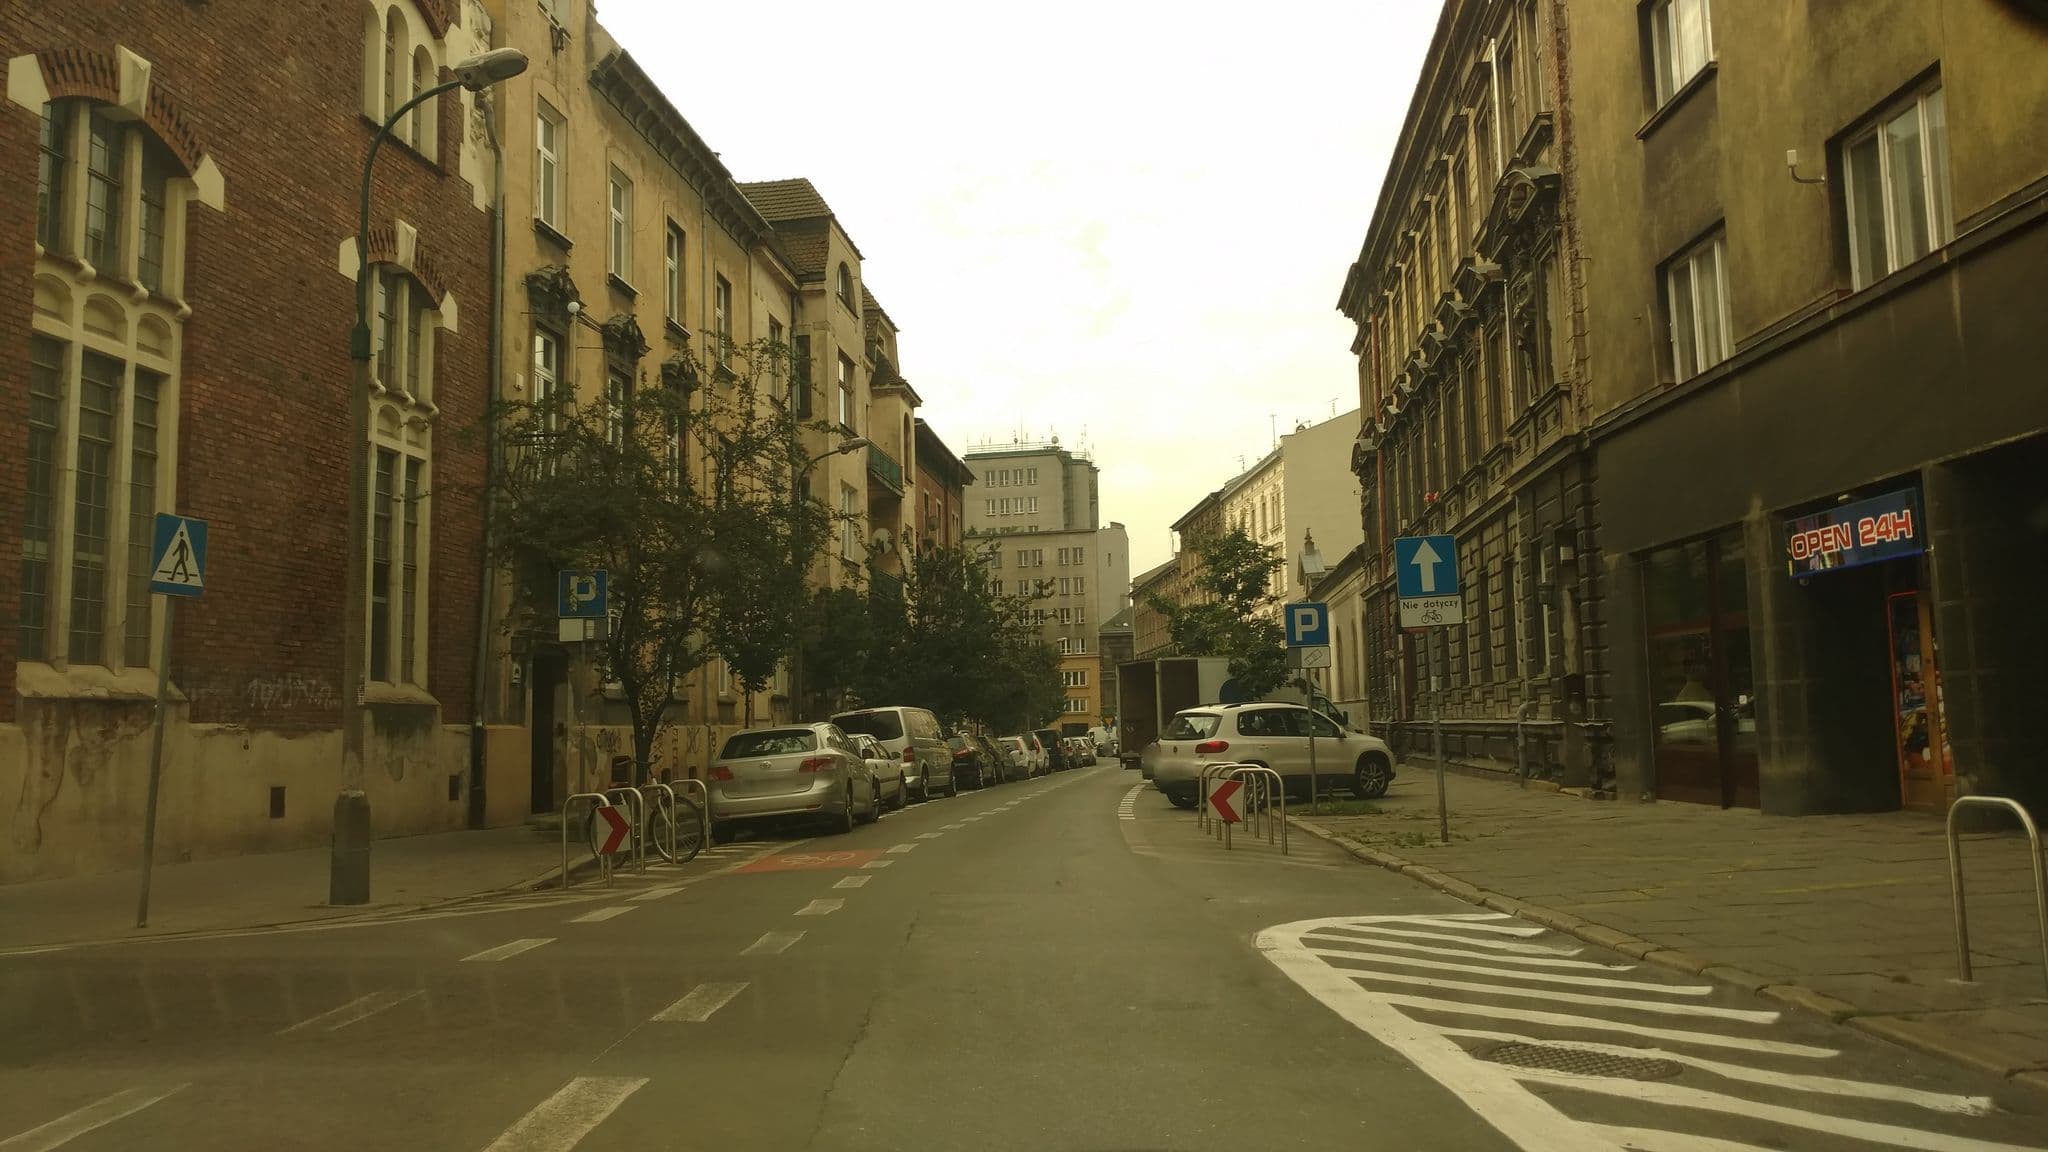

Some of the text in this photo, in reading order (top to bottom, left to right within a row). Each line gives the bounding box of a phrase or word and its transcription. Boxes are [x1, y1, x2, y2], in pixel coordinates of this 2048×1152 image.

[1791, 509, 1913, 560] OPEN 24H
[569, 575, 596, 612] P
[1402, 600, 1458, 609] Nie dotyczy
[1294, 607, 1320, 641] P
